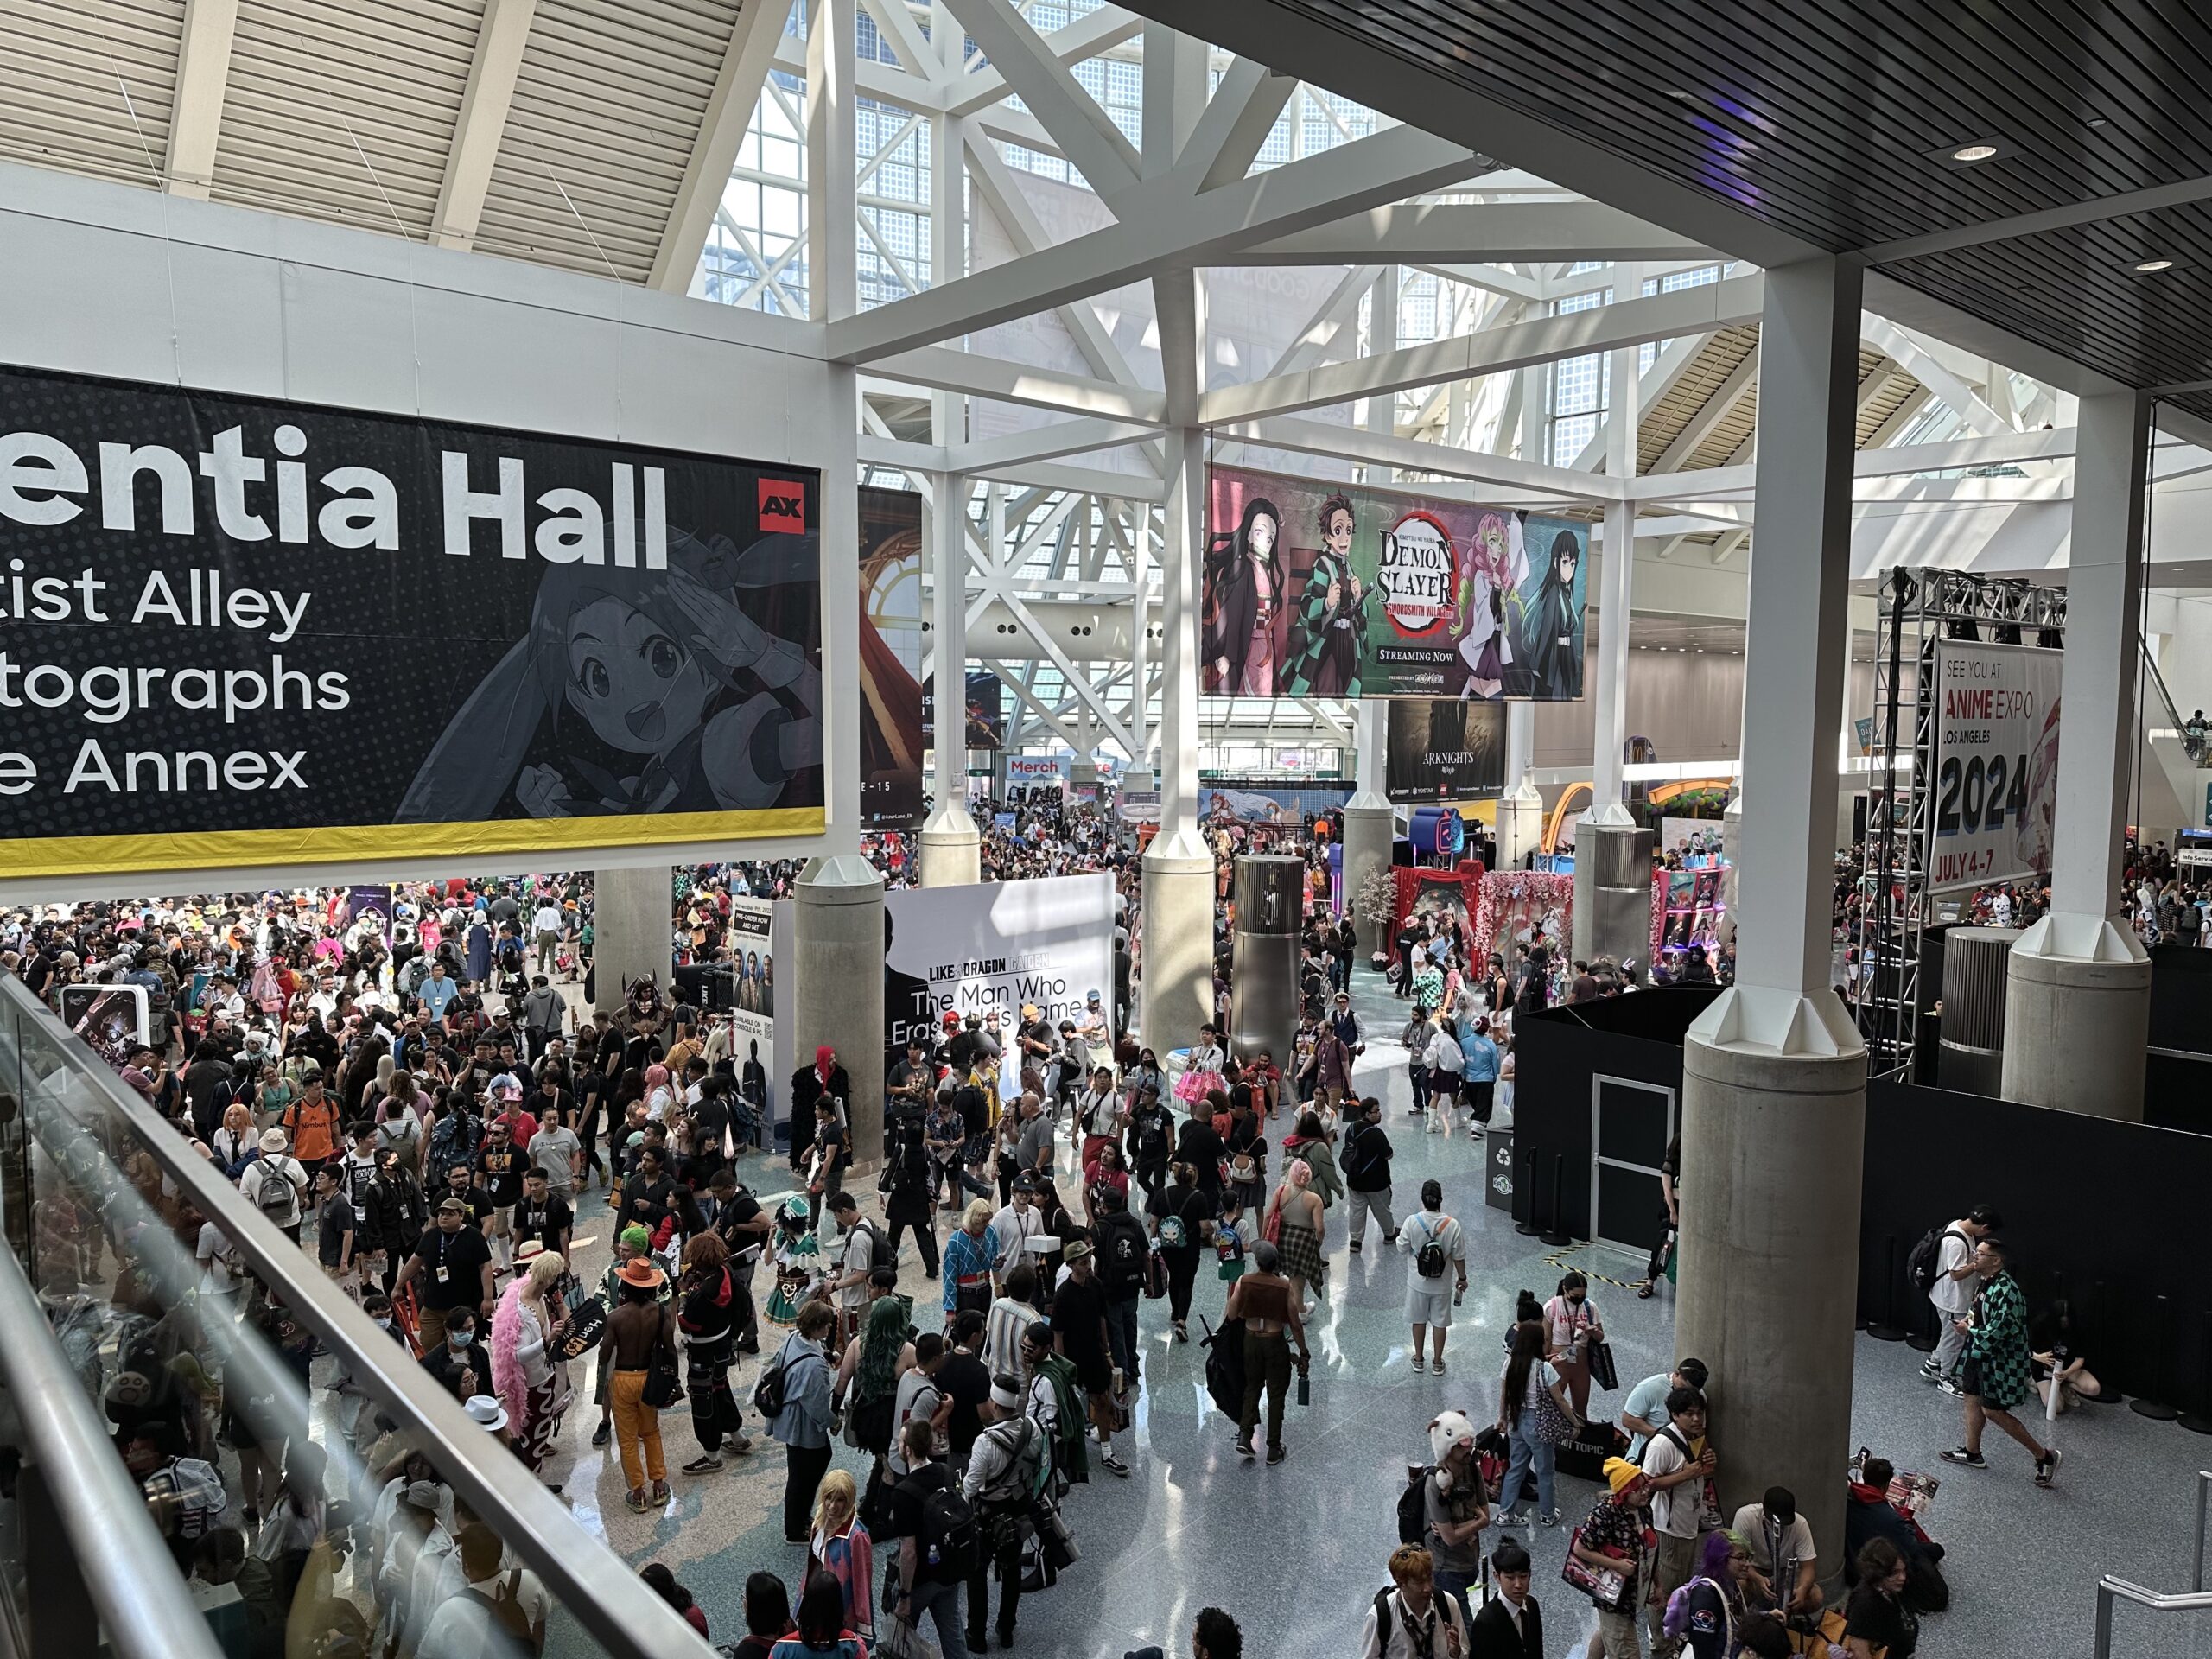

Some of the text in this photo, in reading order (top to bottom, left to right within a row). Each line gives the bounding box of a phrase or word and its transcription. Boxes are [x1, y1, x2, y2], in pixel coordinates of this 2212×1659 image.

[0, 425, 668, 570] entia Hall
[760, 495, 804, 519] AX
[1378, 530, 1456, 573] DEMON
[0, 558, 312, 643] ist Alley
[1375, 570, 1456, 607] SLAYER
[1388, 603, 1425, 616] SWORDSMITH
[1426, 605, 1446, 617] VILLAGE
[1379, 649, 1454, 662] STREAMING NOW
[1947, 660, 2002, 679] SEE YOU AT
[0, 651, 350, 723] tographs
[1945, 689, 2033, 720] ANIME EXPO
[1958, 729, 1990, 744] ANGELES
[63, 738, 308, 793] Annex
[1011, 760, 1058, 773] Merch
[1422, 751, 1474, 766] ARKNIGHTS
[1936, 754, 2027, 837] 2024
[1936, 852, 1967, 882] JULY
[929, 964, 955, 982] LIKE
[963, 958, 1006, 976] DRAGON
[1009, 953, 1049, 971] GAIDEN
[911, 976, 1066, 1016] The Man Who
[1574, 1441, 1604, 1455] TOPIC
